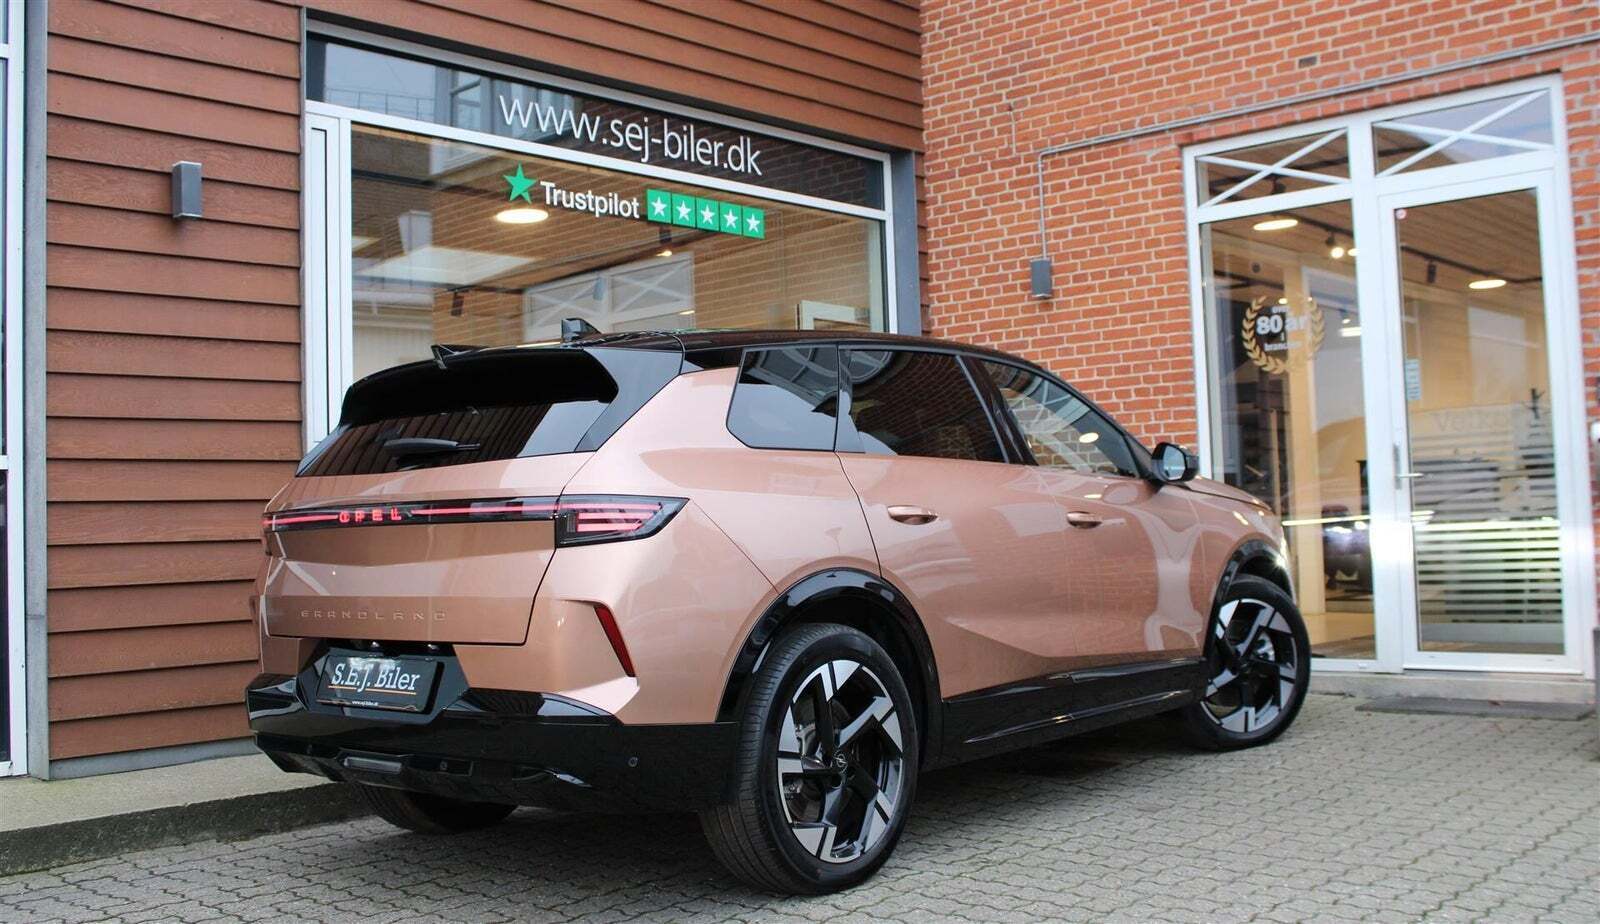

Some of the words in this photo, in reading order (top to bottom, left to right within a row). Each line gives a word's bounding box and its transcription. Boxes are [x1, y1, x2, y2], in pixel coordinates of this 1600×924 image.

[500, 95, 762, 176] www.sej-biler.dk
[540, 180, 640, 218] Trustpilot
[1256, 314, 1283, 335] 80
[338, 507, 402, 523] OPEL
[331, 662, 371, 693] S.E.J.
[374, 662, 420, 691] Biler
